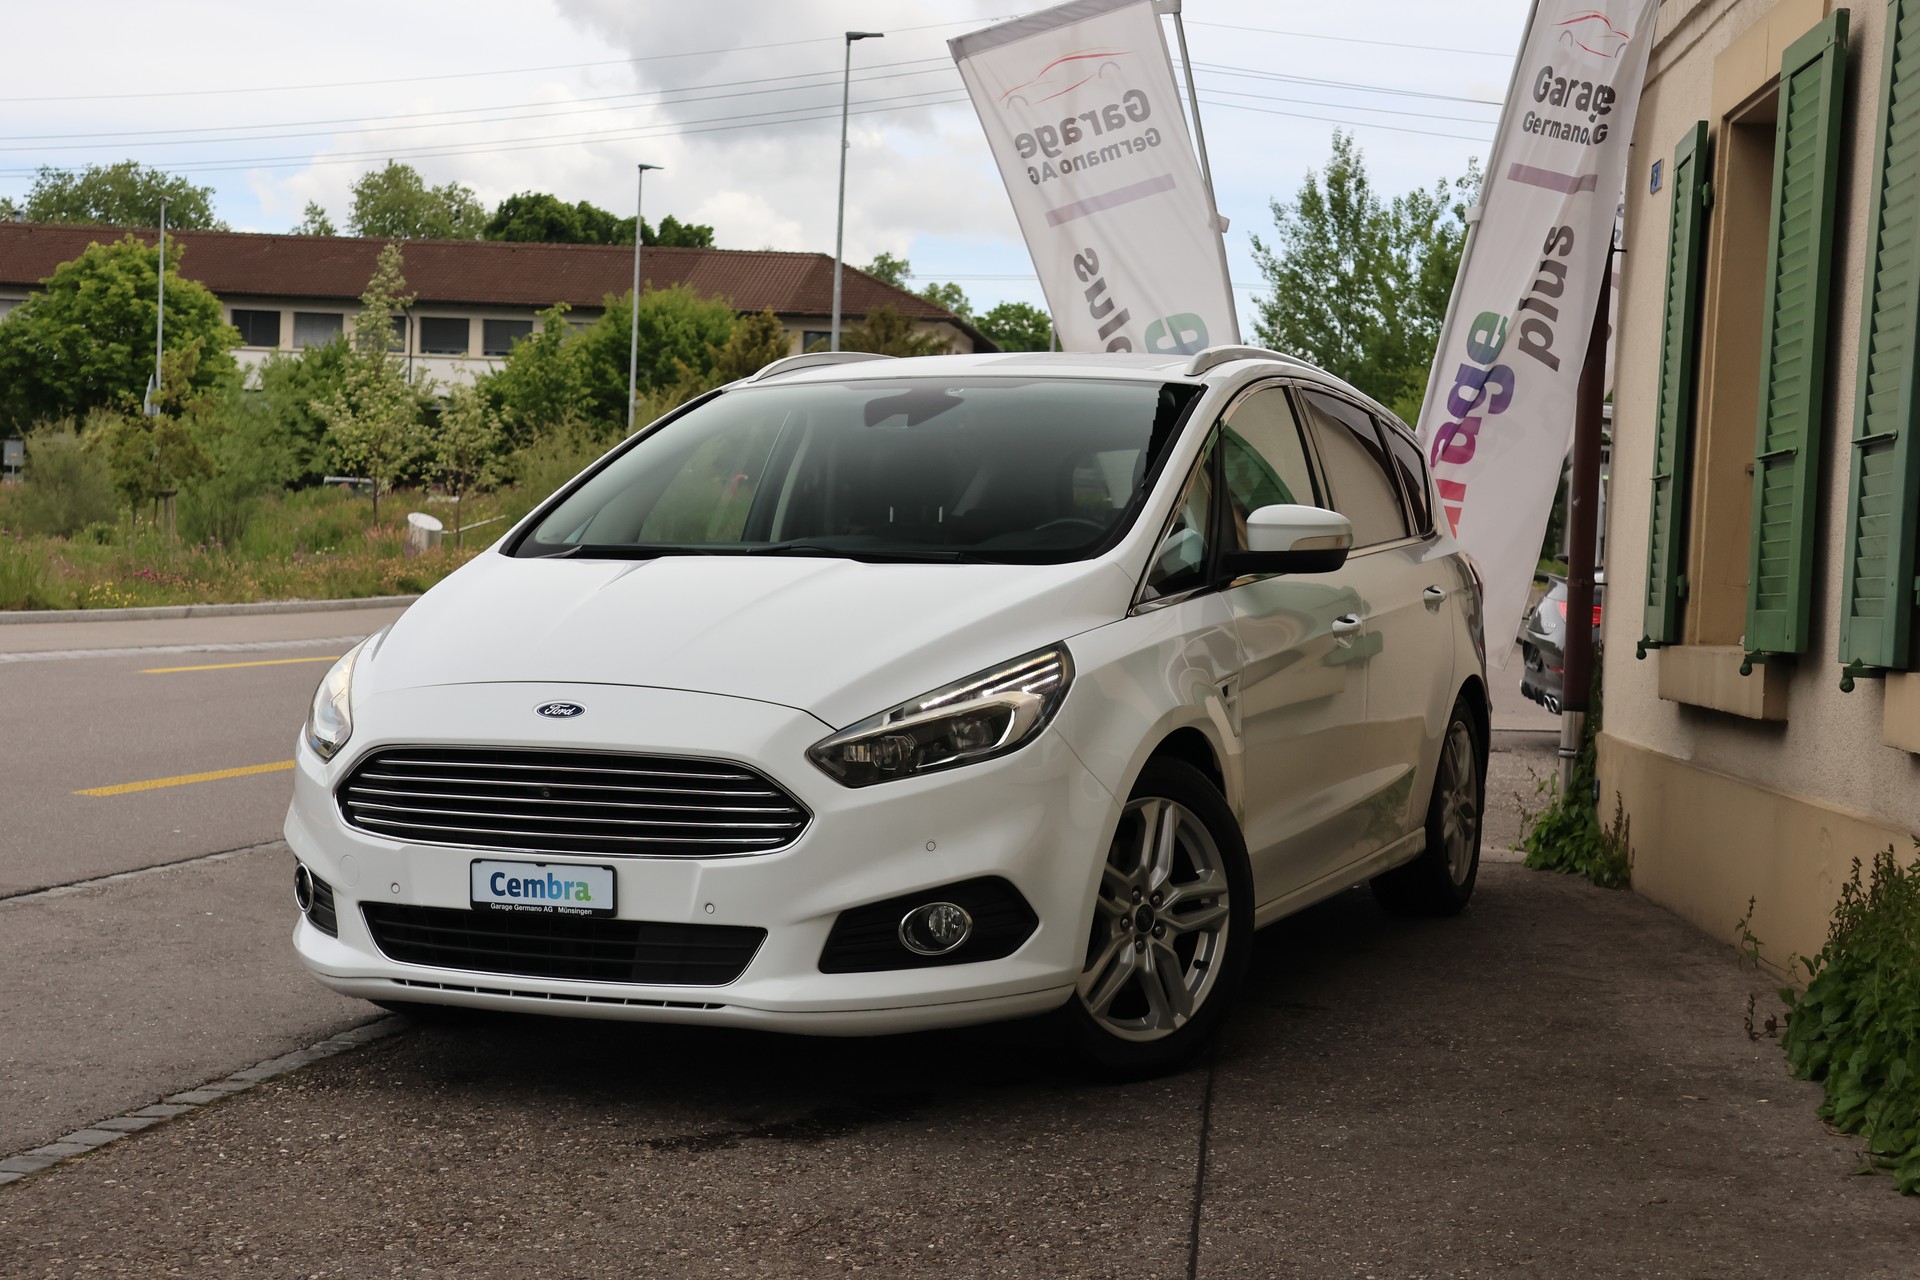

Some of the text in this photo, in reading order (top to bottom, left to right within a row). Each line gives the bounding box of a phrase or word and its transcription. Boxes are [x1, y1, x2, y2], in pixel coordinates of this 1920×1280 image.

[1533, 65, 1616, 123] Garage
[1522, 111, 1590, 144] Germano
[1517, 225, 1575, 373] plus
[544, 703, 576, 716] Ford
[490, 871, 592, 902] Cembra
[490, 902, 513, 911] Garage
[513, 903, 542, 913] Germano
[557, 906, 592, 916] Münsingen
